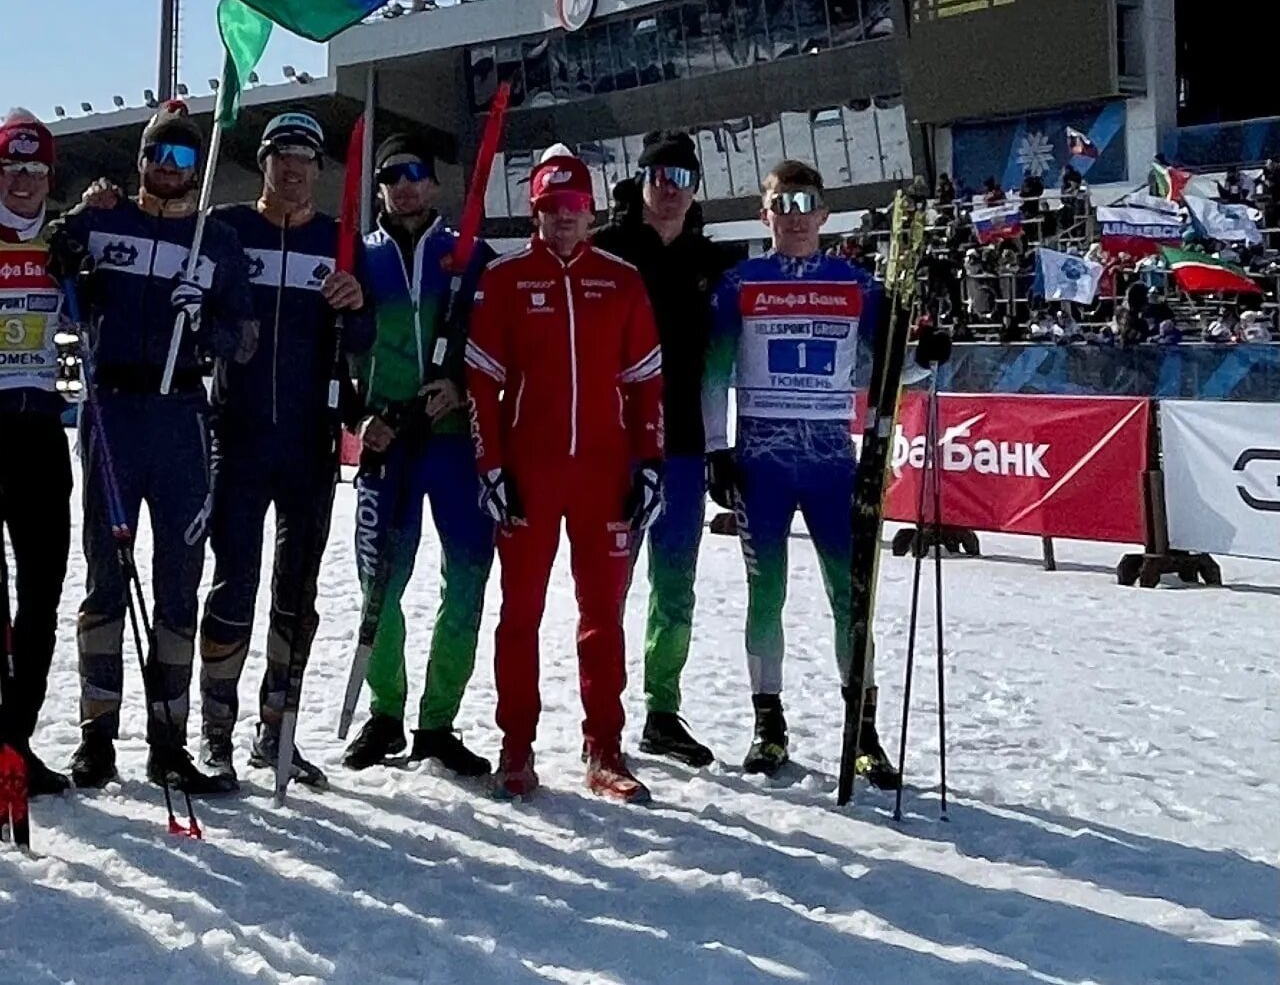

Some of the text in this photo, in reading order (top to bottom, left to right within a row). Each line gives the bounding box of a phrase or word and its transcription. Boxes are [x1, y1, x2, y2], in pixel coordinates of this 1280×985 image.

[755, 292, 848, 308] Альфа Банк
[755, 323, 811, 335] TELESPORT
[796, 342, 807, 368] 1
[769, 376, 832, 388] ТЮМЕНЬ
[941, 413, 1050, 478] Банк
